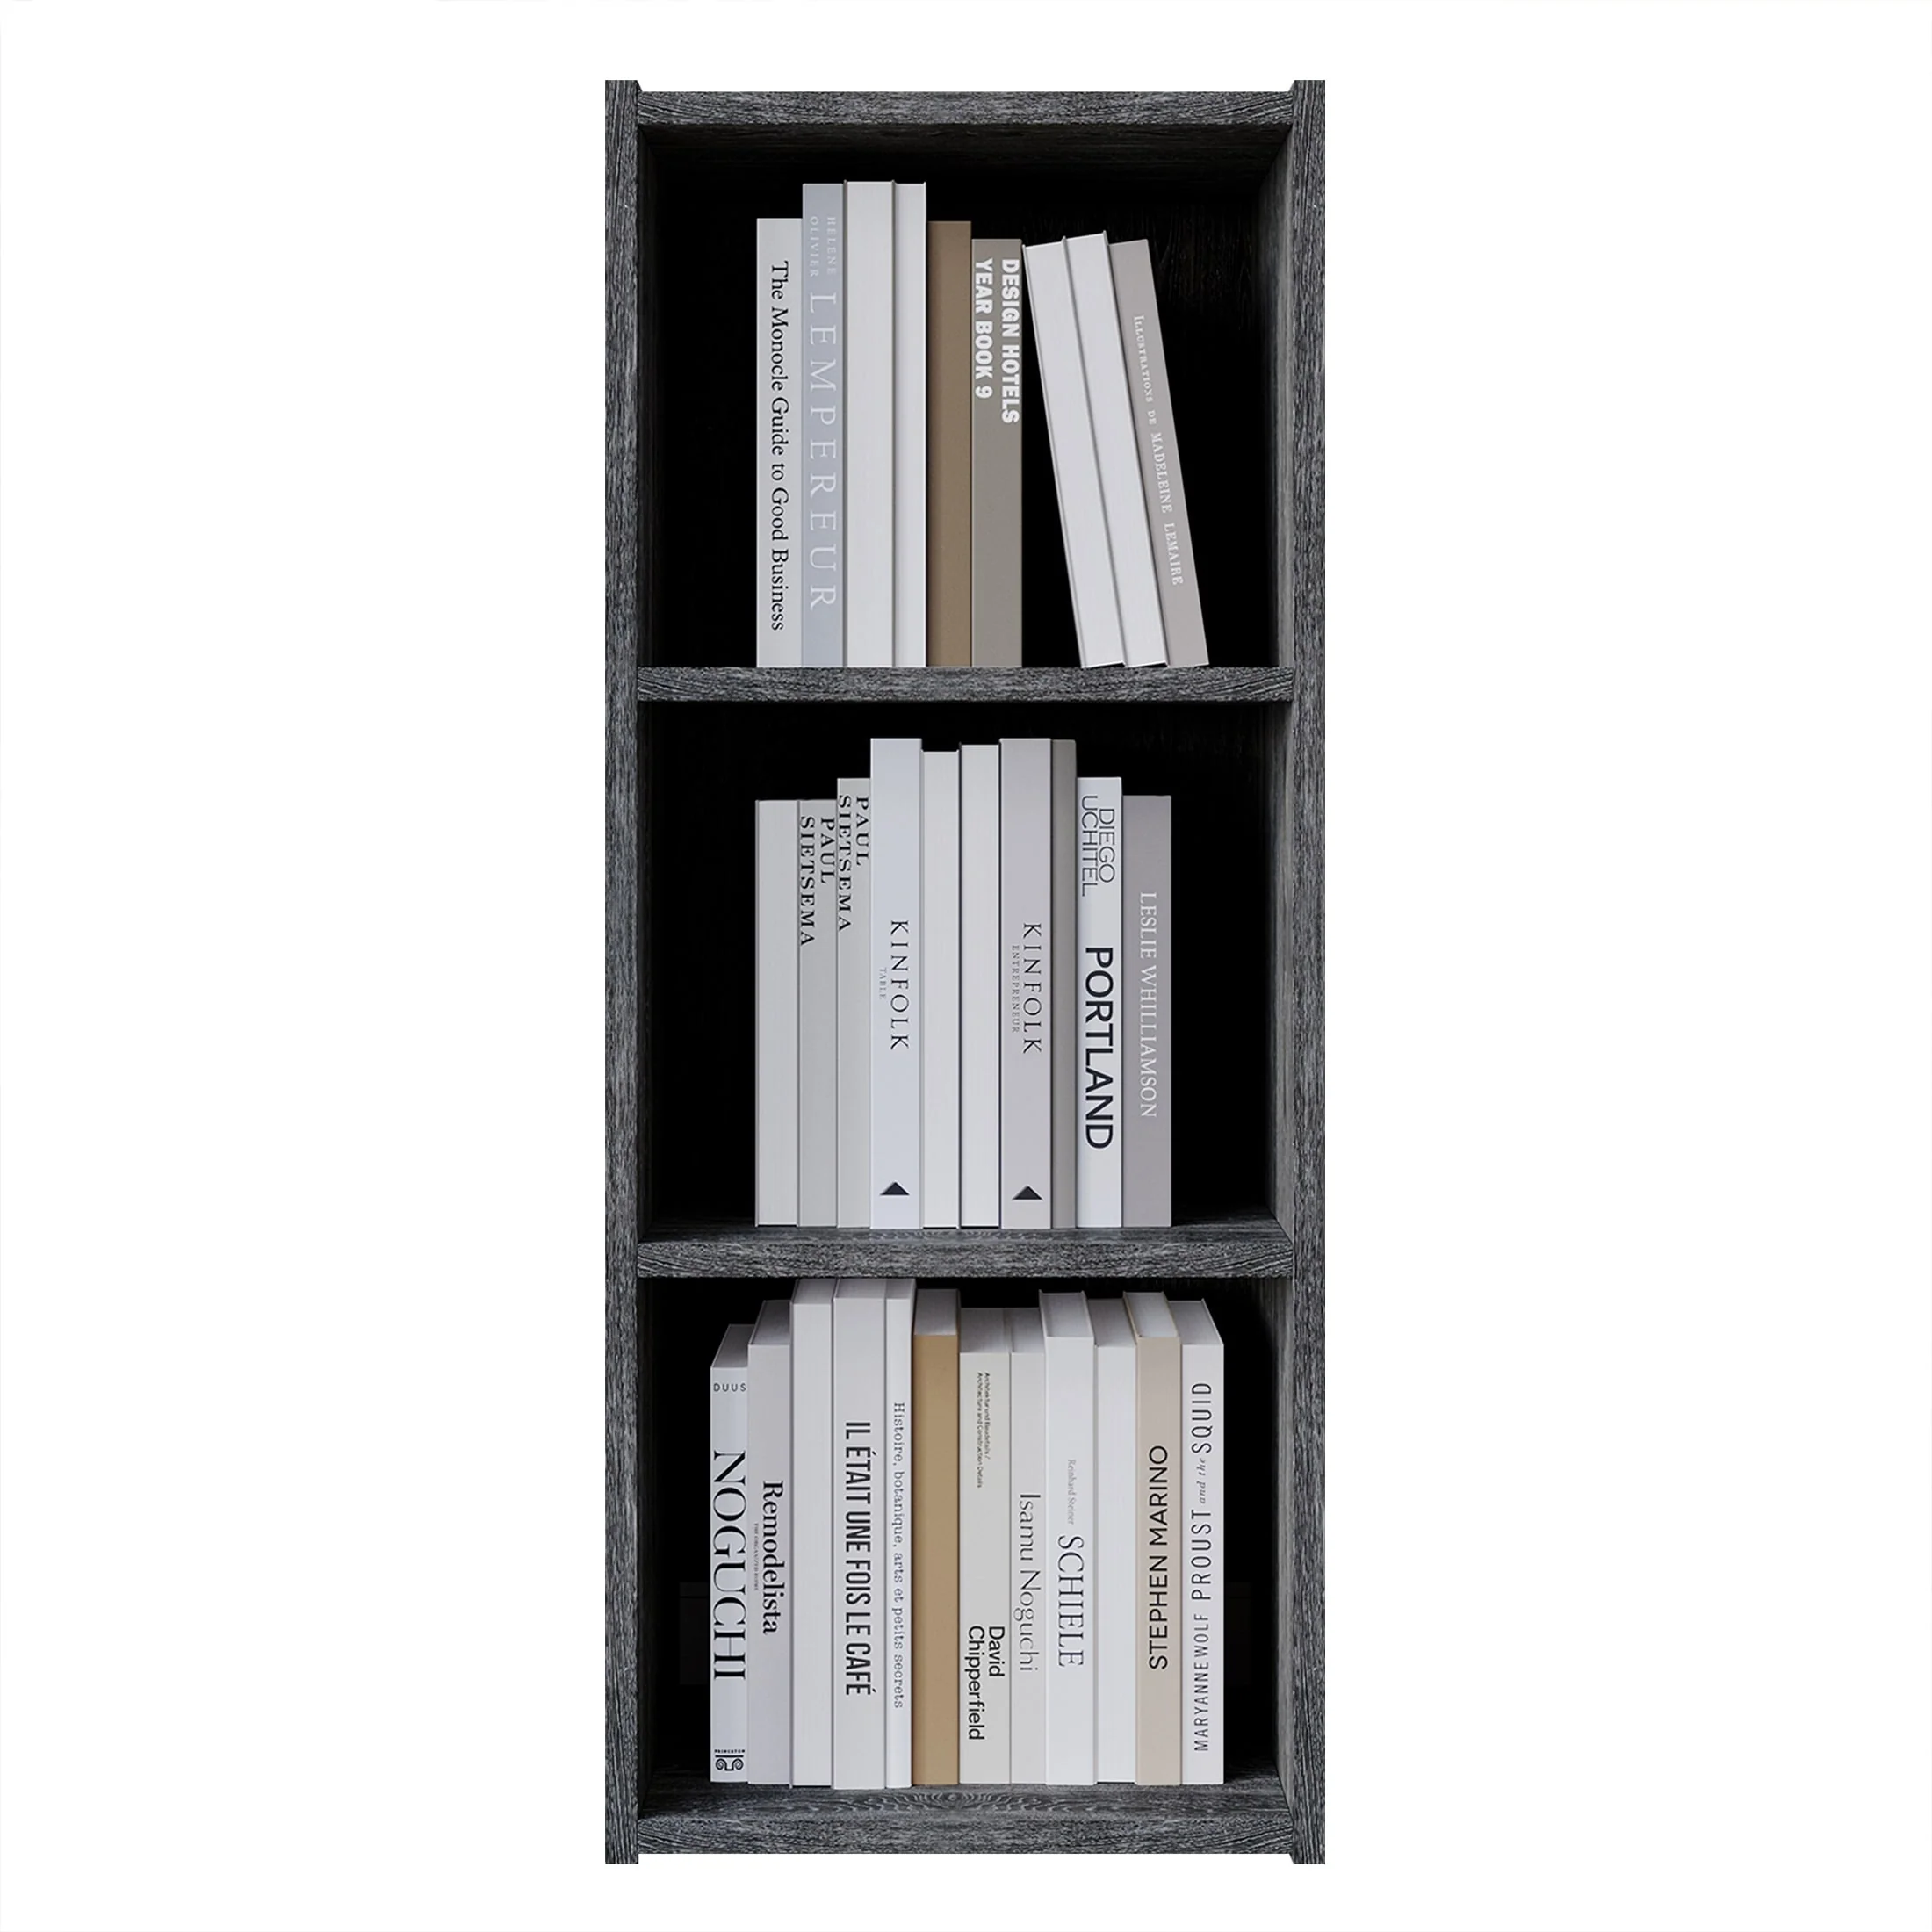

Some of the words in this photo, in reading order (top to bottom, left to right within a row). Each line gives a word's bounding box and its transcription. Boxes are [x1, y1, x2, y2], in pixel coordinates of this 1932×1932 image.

[810, 216, 819, 277] OLIVIER
[771, 261, 789, 299] The
[975, 258, 992, 314] YEAR
[1002, 259, 1019, 337] DESIGN
[771, 307, 789, 391] Monocle
[975, 321, 992, 379] BOOK
[975, 386, 992, 399] 9
[1002, 345, 1020, 423] HOTELS
[771, 397, 789, 456] Guide
[810, 292, 836, 611] LEMPEREUR
[771, 464, 787, 481] to
[771, 487, 789, 541] Good
[1150, 433, 1173, 514] MADELEINE
[1164, 523, 1183, 586] LEMAIRE
[771, 550, 789, 631] Business
[821, 818, 835, 884] PAUL
[839, 795, 852, 931] SIETSEMA
[856, 797, 869, 866] PAUL
[1082, 796, 1098, 896] UCHITEL
[1099, 808, 1115, 883] DIEGO
[800, 816, 815, 946] SIETSEMA
[1140, 892, 1157, 959] LESLIE
[890, 920, 909, 1050] KINFOLK
[1023, 923, 1042, 1054] KINFOLK
[1085, 948, 1114, 1149] PORTLAND
[1140, 965, 1157, 1117] WHILLIAMSON
[713, 1383, 746, 1392] DUUS
[1191, 1382, 1213, 1453] SQUID
[846, 1422, 870, 1439] IL
[891, 1402, 905, 1466] Histoire,
[846, 1446, 876, 1504] ÉTAIT
[1067, 1460, 1076, 1495] Reinhard
[1150, 1445, 1168, 1546] MARINO
[1195, 1458, 1207, 1476] the
[1196, 1481, 1207, 1504] and
[846, 1511, 870, 1552] UNE
[892, 1471, 905, 1547] botanique,
[1020, 1494, 1040, 1561] Isamu
[1067, 1497, 1076, 1525] Steiner
[713, 1450, 746, 1680] NOGUCHI
[763, 1481, 785, 1634] Remodelista
[846, 1561, 870, 1605] FOIS
[894, 1553, 905, 1582] arts
[1191, 1510, 1211, 1599] PROUST
[846, 1612, 870, 1635] LE
[892, 1607, 905, 1649] petits
[894, 1589, 904, 1603] et
[1014, 1570, 1040, 1672] Noguchi
[1058, 1535, 1084, 1668] SCHIELE
[1150, 1554, 1168, 1669] STEPHEN
[988, 1626, 1005, 1676] David
[1193, 1613, 1208, 1658] WOLF
[846, 1643, 876, 1696] CAFÉ
[894, 1654, 905, 1708] secrets
[964, 1626, 984, 1740] Chipperfield
